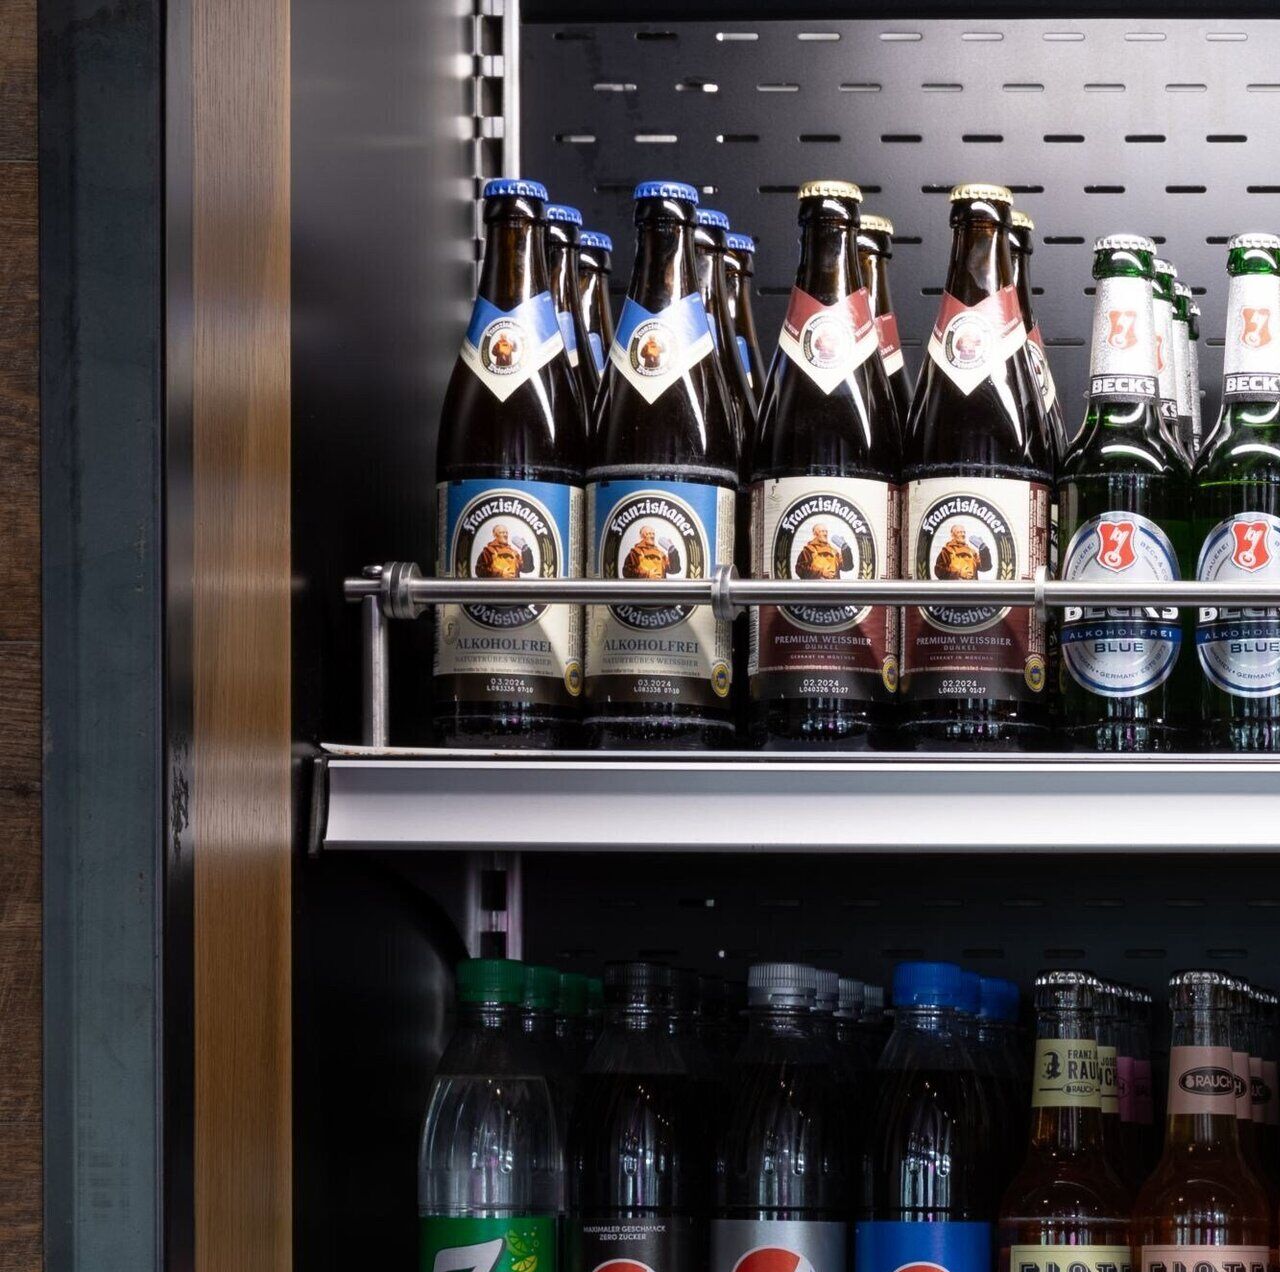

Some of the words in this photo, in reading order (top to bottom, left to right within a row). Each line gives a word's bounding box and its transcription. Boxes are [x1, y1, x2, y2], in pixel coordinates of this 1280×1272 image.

[463, 499, 549, 536] Franziskaner
[611, 500, 695, 536] Franziskaner
[782, 498, 868, 534] Franziskaner
[923, 498, 1006, 534] Franziskaner
[775, 635, 819, 645] PREMIUM
[822, 635, 872, 646] WEISSBIER
[1069, 629, 1173, 641] ALKOHOLFREI
[455, 638, 552, 653] ALKOHOLFREI
[603, 639, 699, 654] ALKOHOLFREI
[1094, 643, 1144, 653] BLUE
[1230, 643, 1280, 654] BLUE
